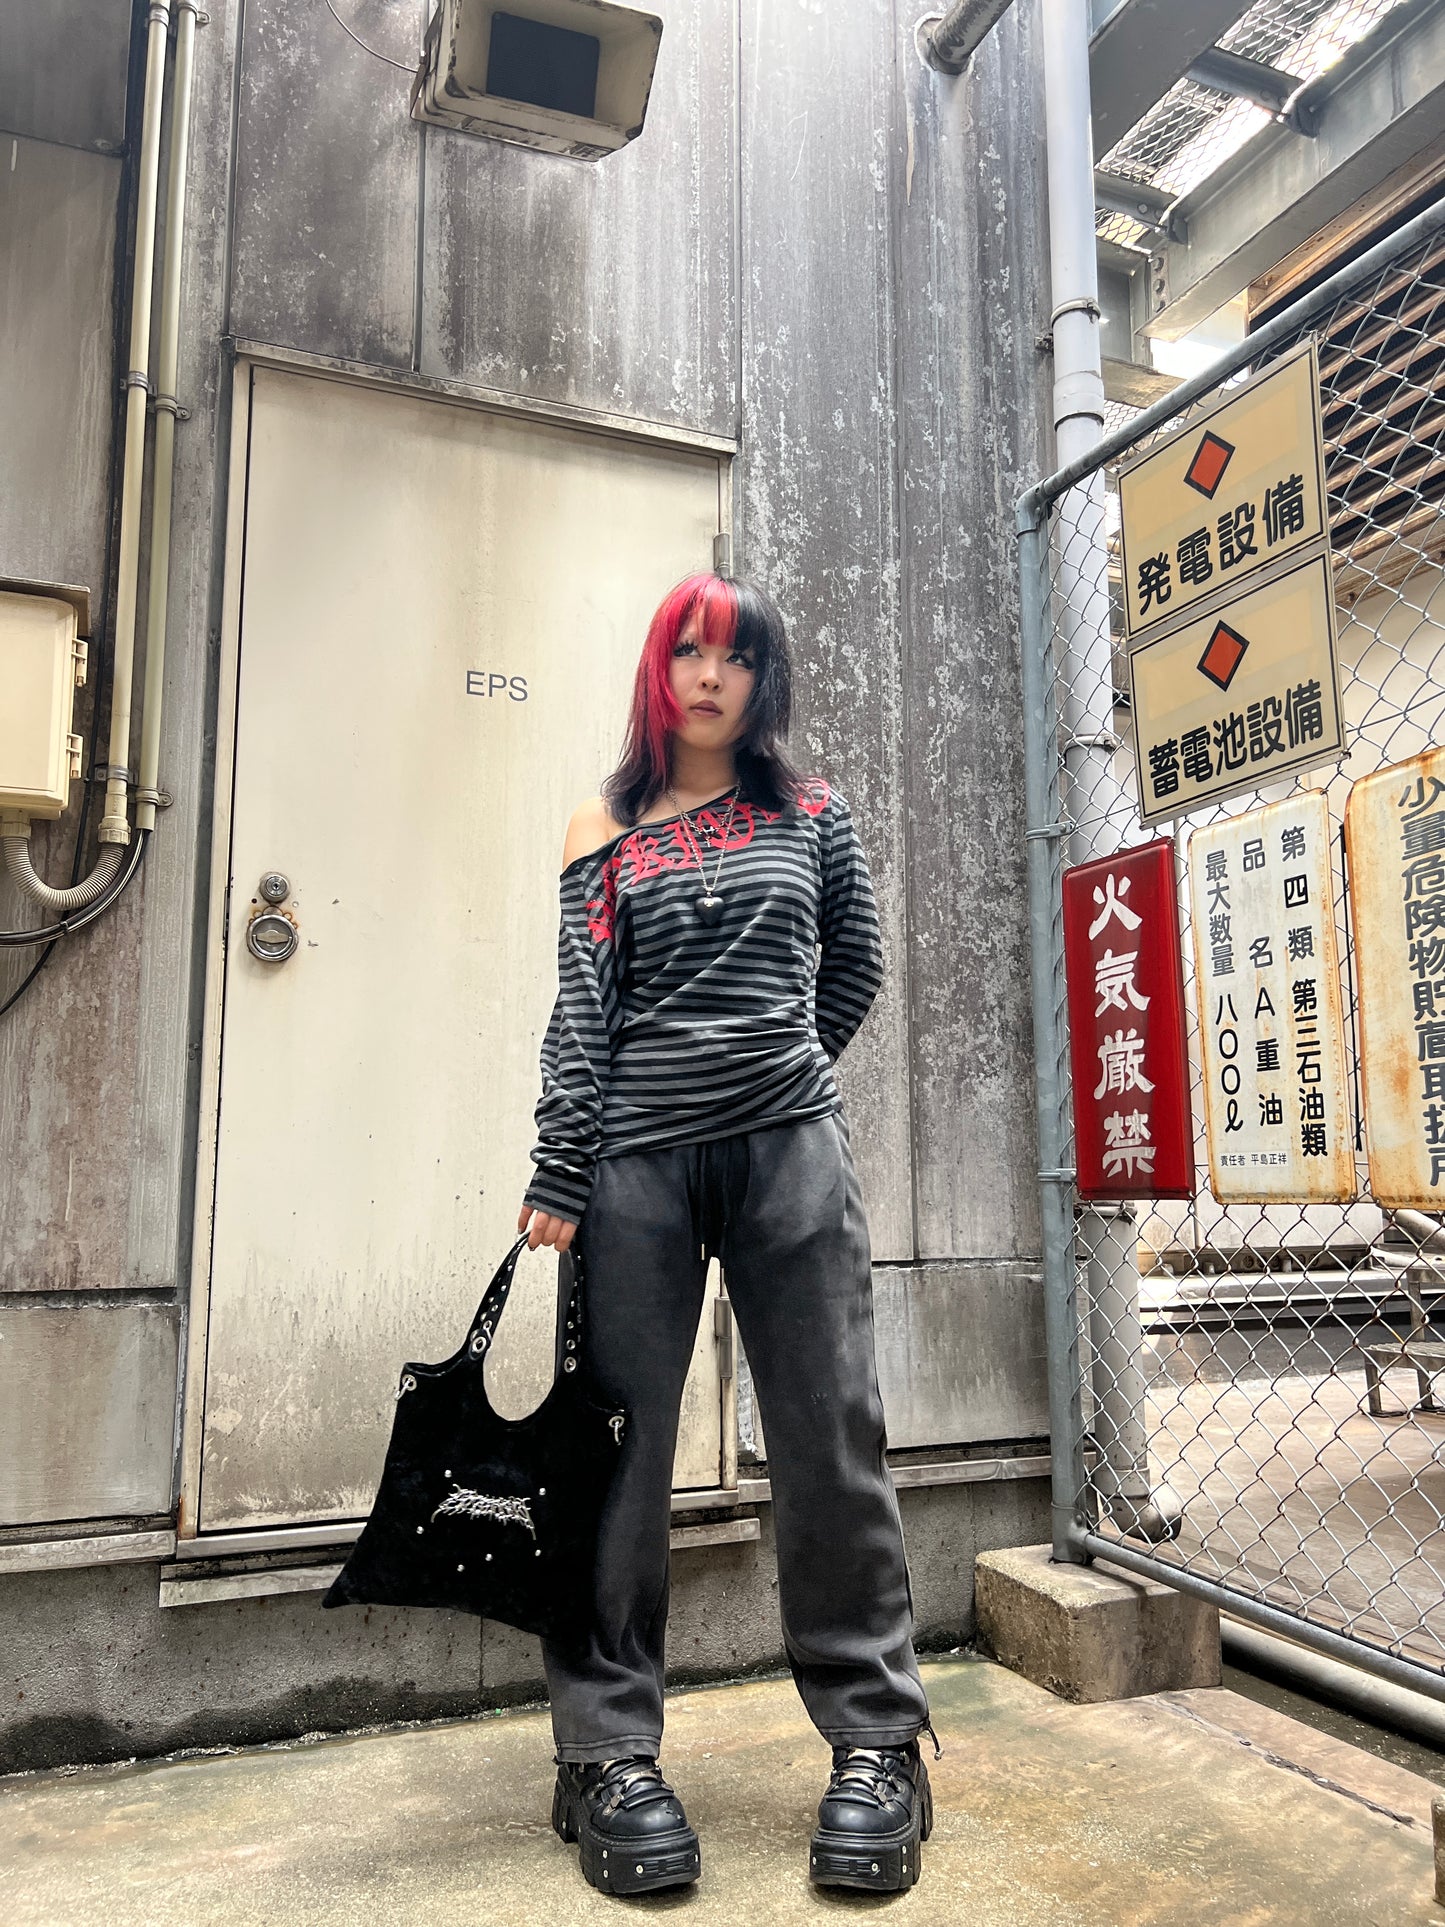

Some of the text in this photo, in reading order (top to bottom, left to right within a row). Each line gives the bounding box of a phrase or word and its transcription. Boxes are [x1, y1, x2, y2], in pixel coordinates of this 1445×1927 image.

[1136, 473, 1305, 615] 発電設備
[466, 670, 528, 702] EPS
[1148, 678, 1322, 799] 蓄電池設備
[1205, 849, 1236, 977] 最大数量
[1088, 873, 1157, 1179] 火気厳禁
[1220, 1155, 1246, 1167] 責任者
